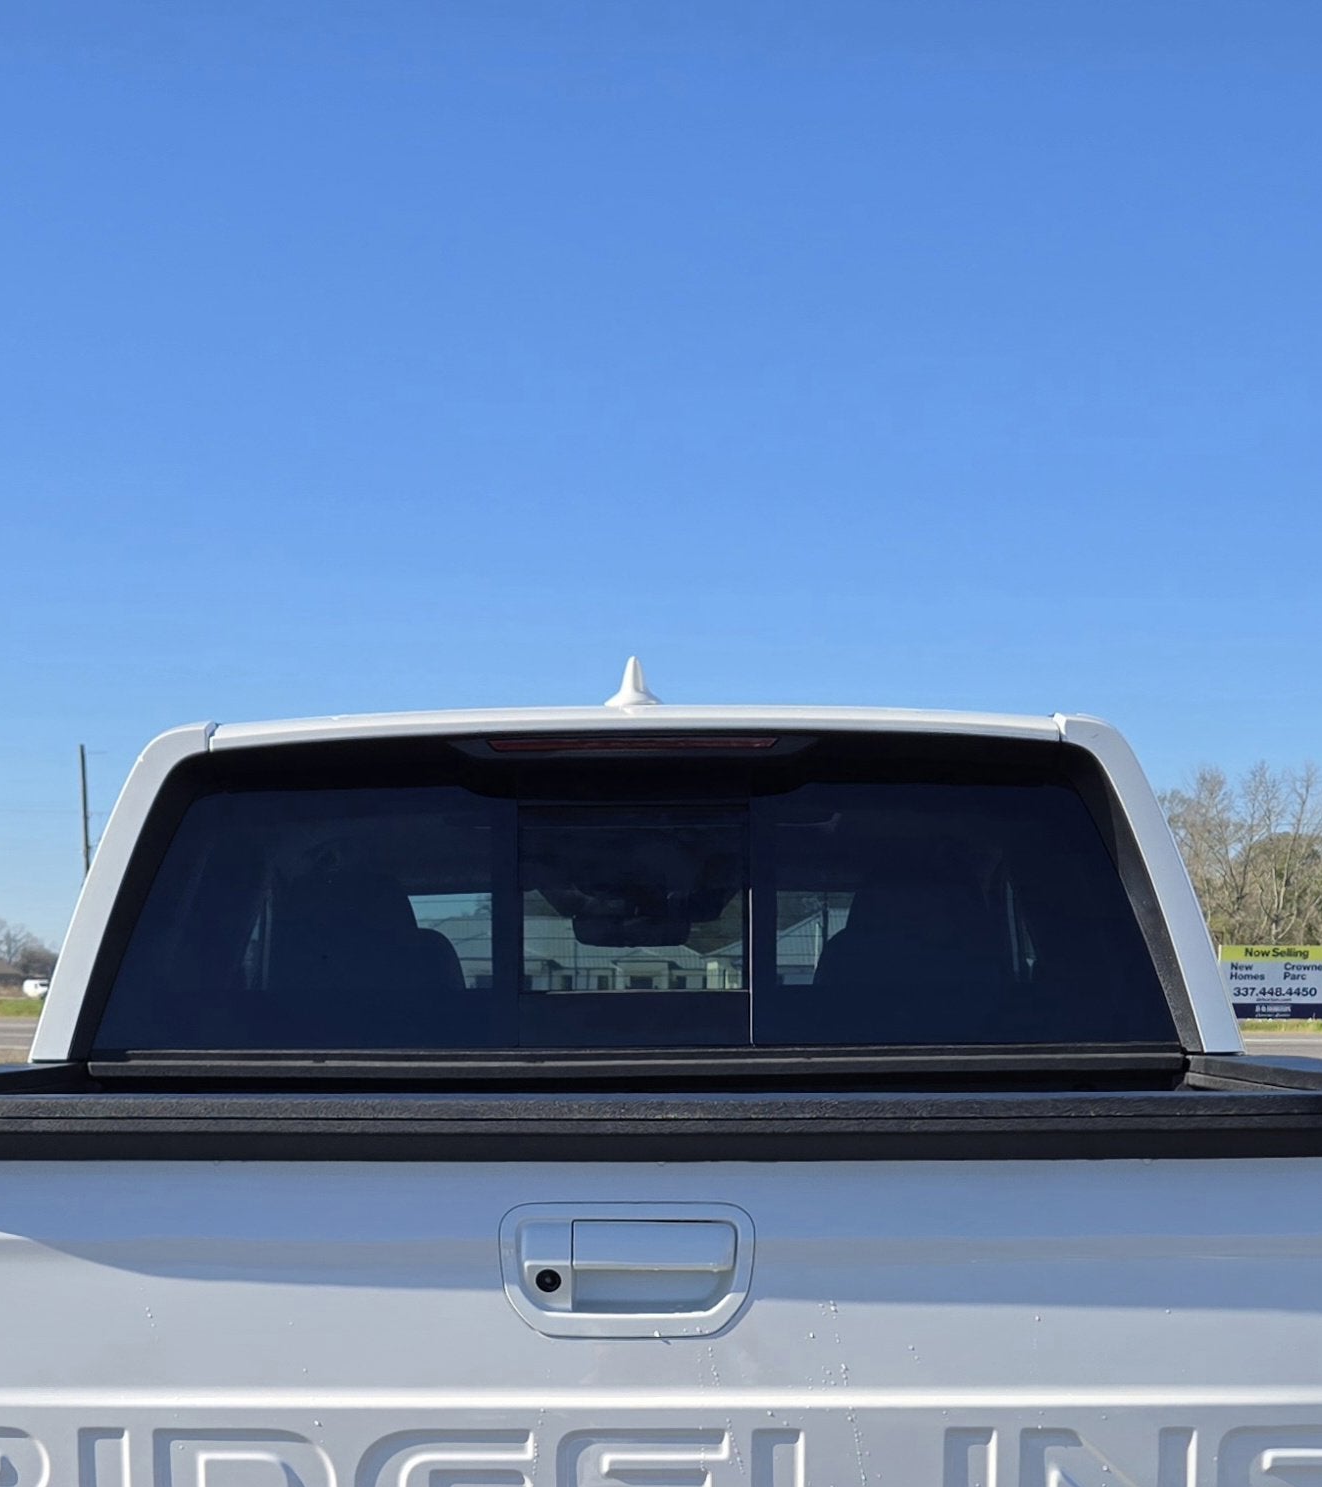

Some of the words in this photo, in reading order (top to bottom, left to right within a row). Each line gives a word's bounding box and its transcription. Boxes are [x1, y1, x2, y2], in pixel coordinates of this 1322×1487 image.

[1244, 947, 1270, 958] Now
[1271, 947, 1310, 959] Selling
[1230, 962, 1254, 971] New
[1229, 971, 1266, 981] Homes
[1283, 971, 1307, 981] Parc
